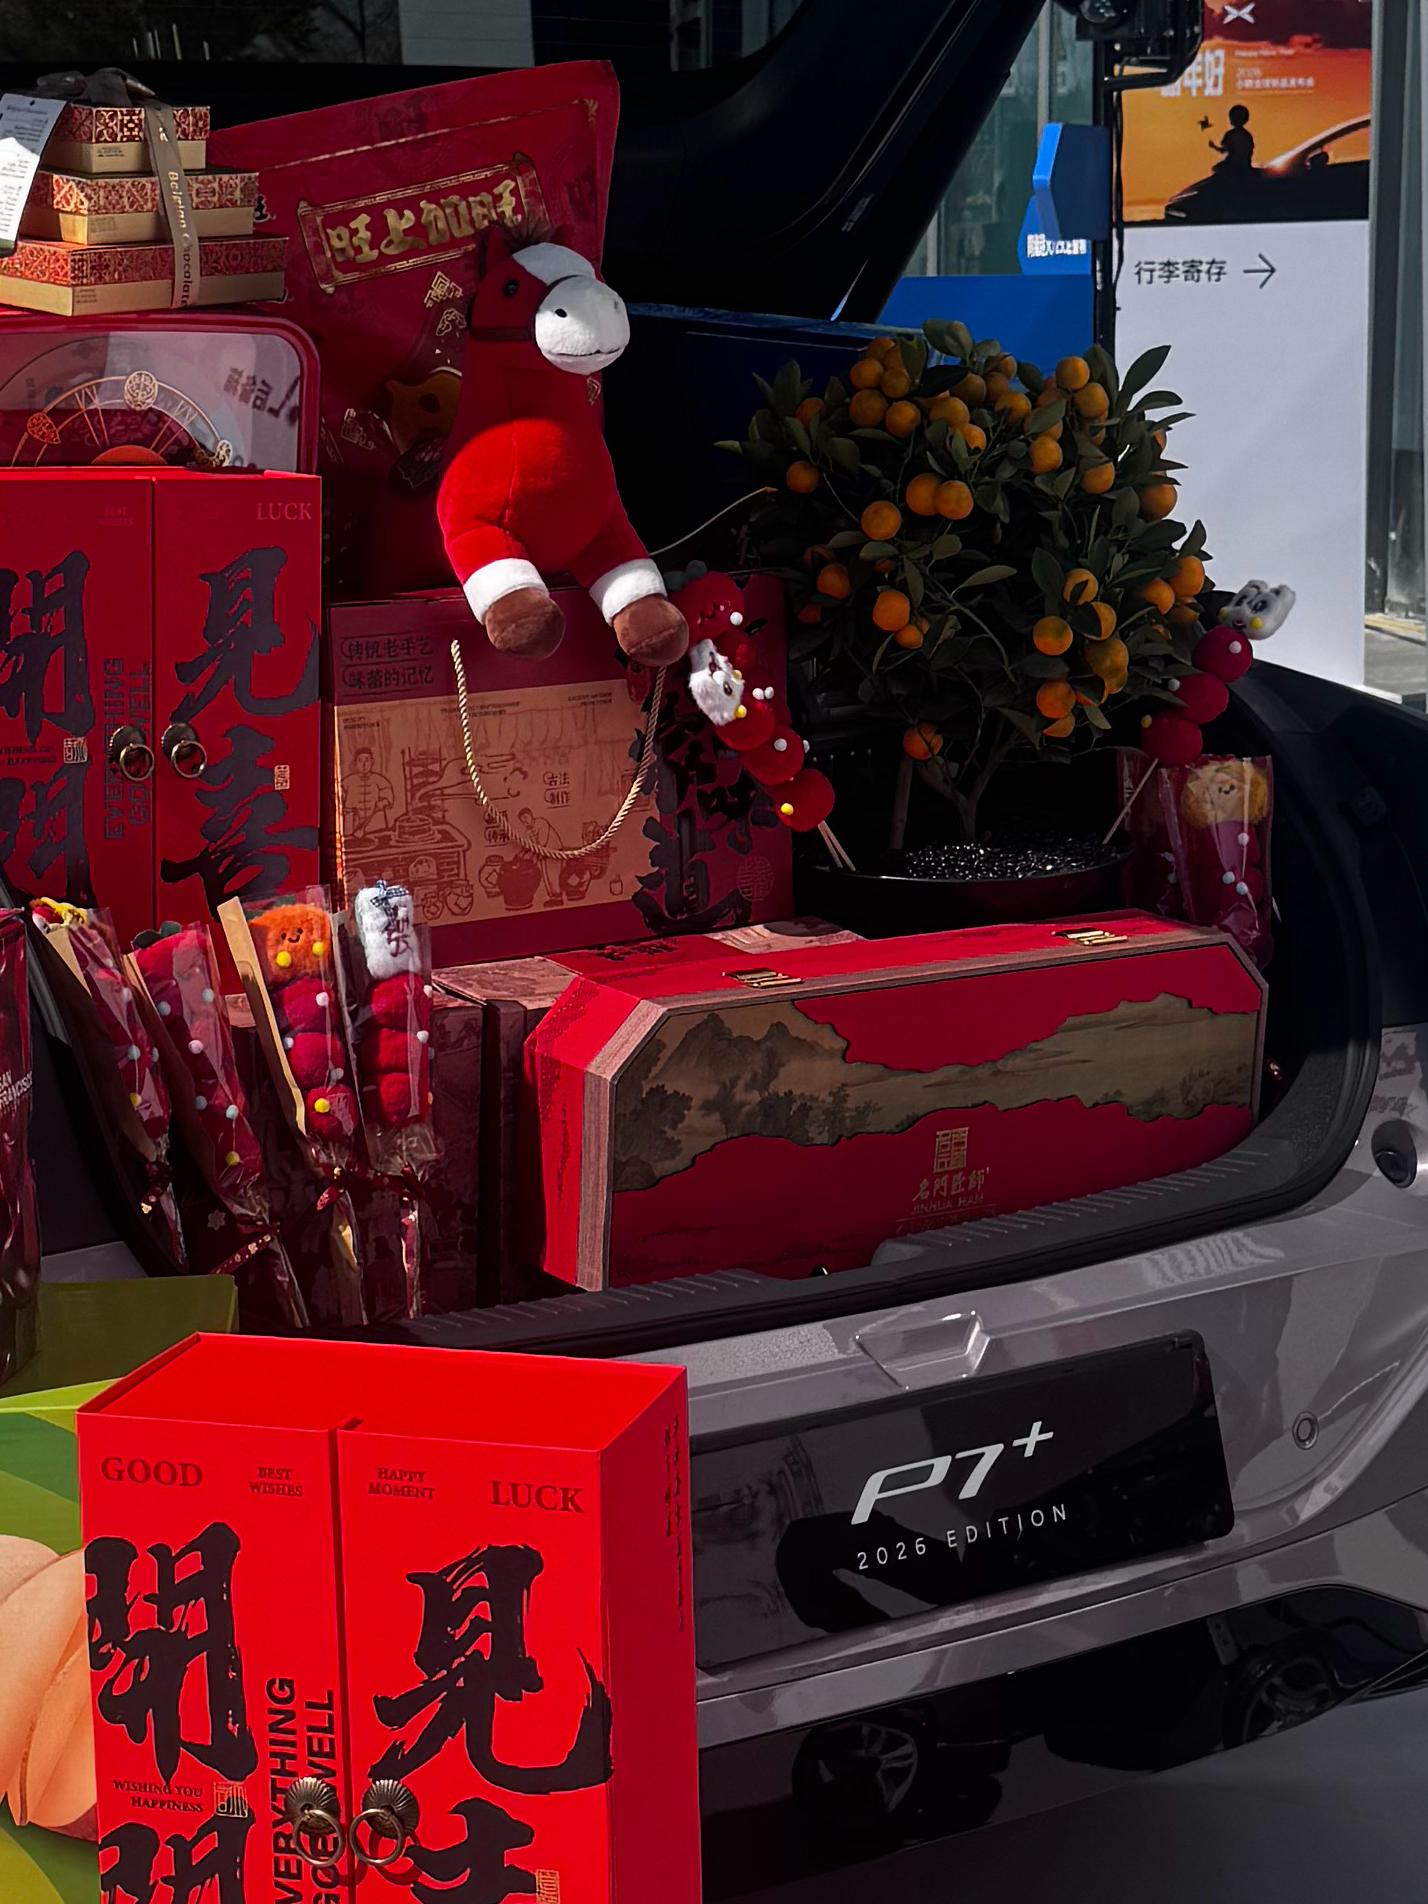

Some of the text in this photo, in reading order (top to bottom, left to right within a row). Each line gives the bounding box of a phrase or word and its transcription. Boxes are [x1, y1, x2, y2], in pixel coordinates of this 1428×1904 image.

[1134, 258, 1228, 286] 行李寄存
[256, 502, 313, 522] LUCK
[100, 1456, 204, 1488] GOOD
[257, 1466, 293, 1481] BEST
[376, 1467, 426, 1483] HAPPY
[850, 1420, 1055, 1526] P7+
[249, 1481, 304, 1498] WISHES
[368, 1482, 436, 1500] MOMENT
[489, 1479, 585, 1514] LUCK
[856, 1502, 1069, 1571] 2026 EDITION
[113, 1779, 203, 1798] WISHING YOU
[131, 1796, 204, 1813] HAPPINESS
